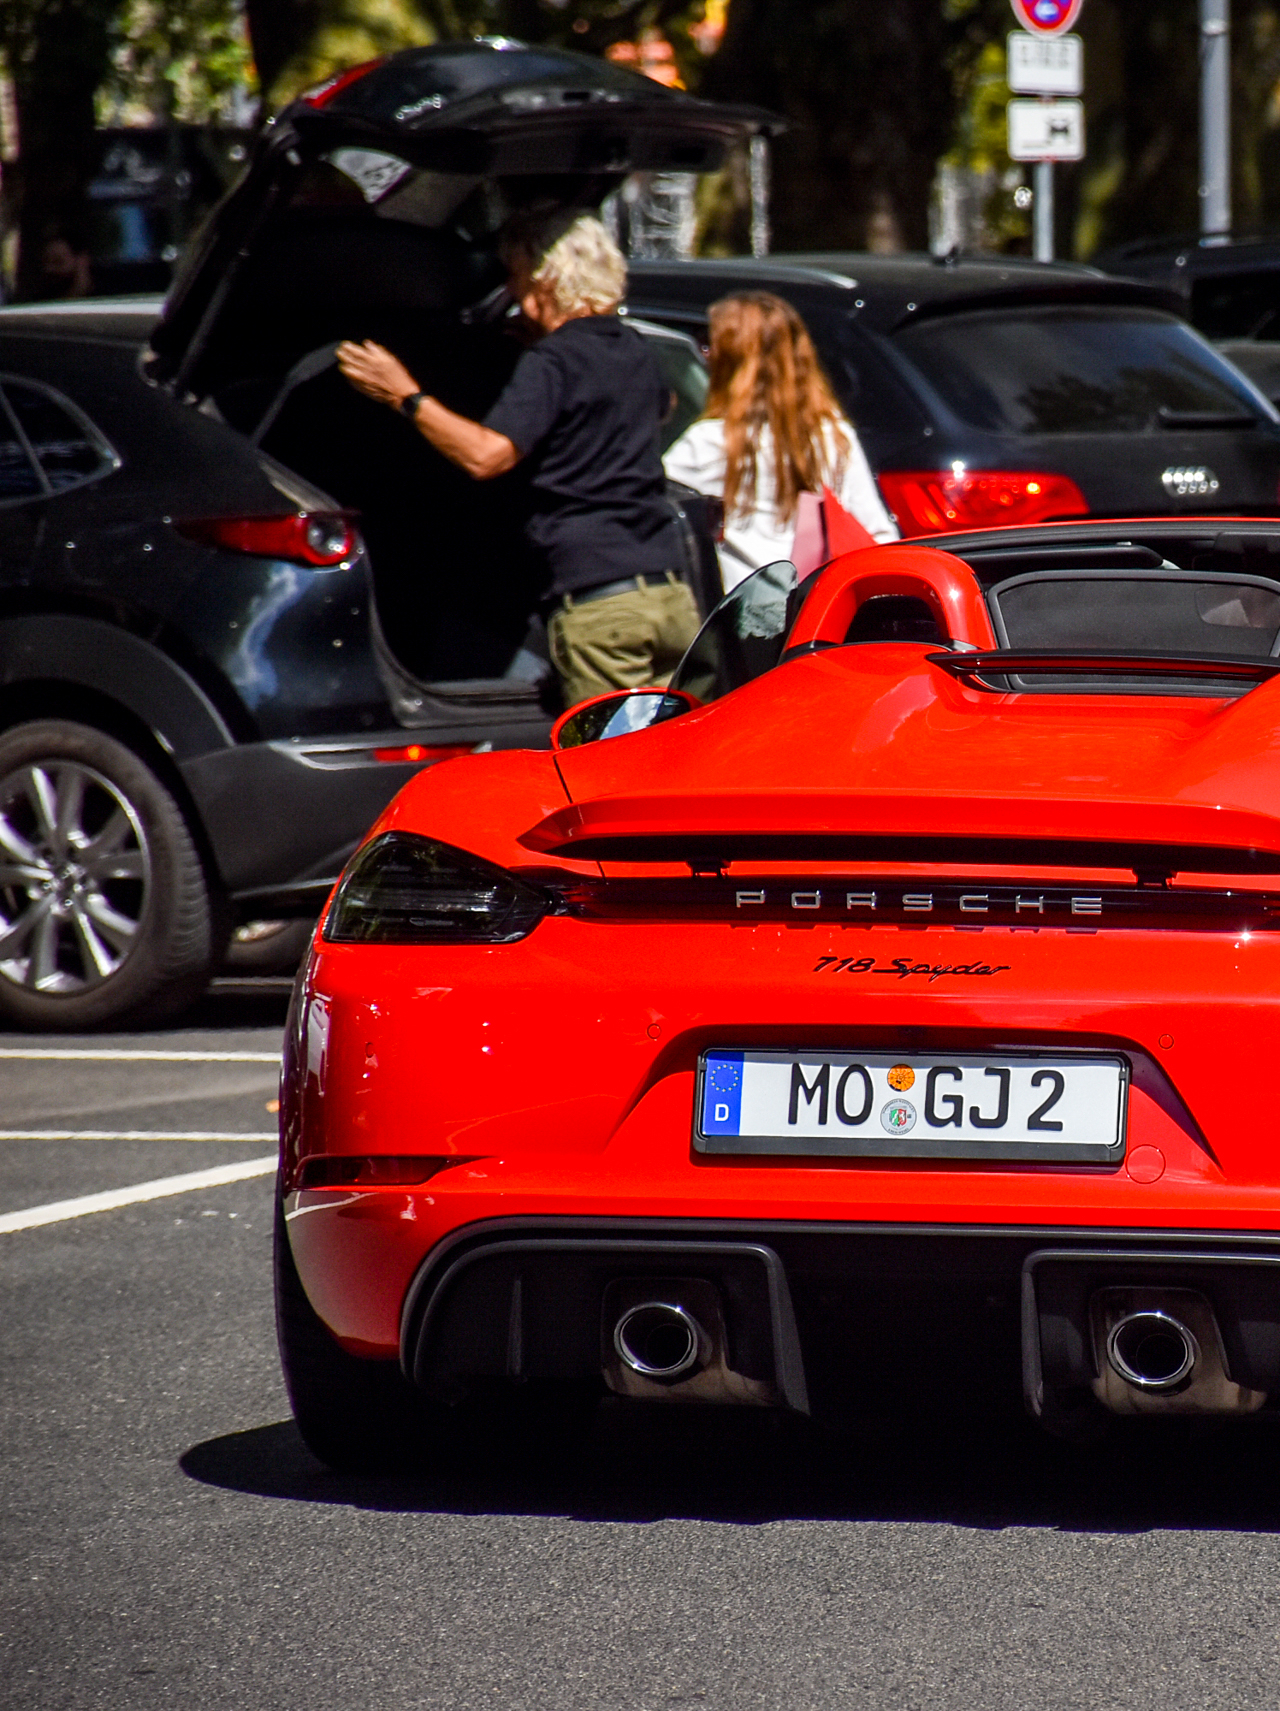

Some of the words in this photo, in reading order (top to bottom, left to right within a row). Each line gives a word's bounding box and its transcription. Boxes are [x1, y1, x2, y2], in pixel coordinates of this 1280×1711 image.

[736, 889, 1102, 915] PORSCHE
[813, 956, 875, 974] 718
[872, 957, 1011, 983] Spyder
[788, 1063, 874, 1126] MO
[924, 1065, 1010, 1129] GJ
[1027, 1069, 1065, 1132] 2
[714, 1103, 730, 1122] D
